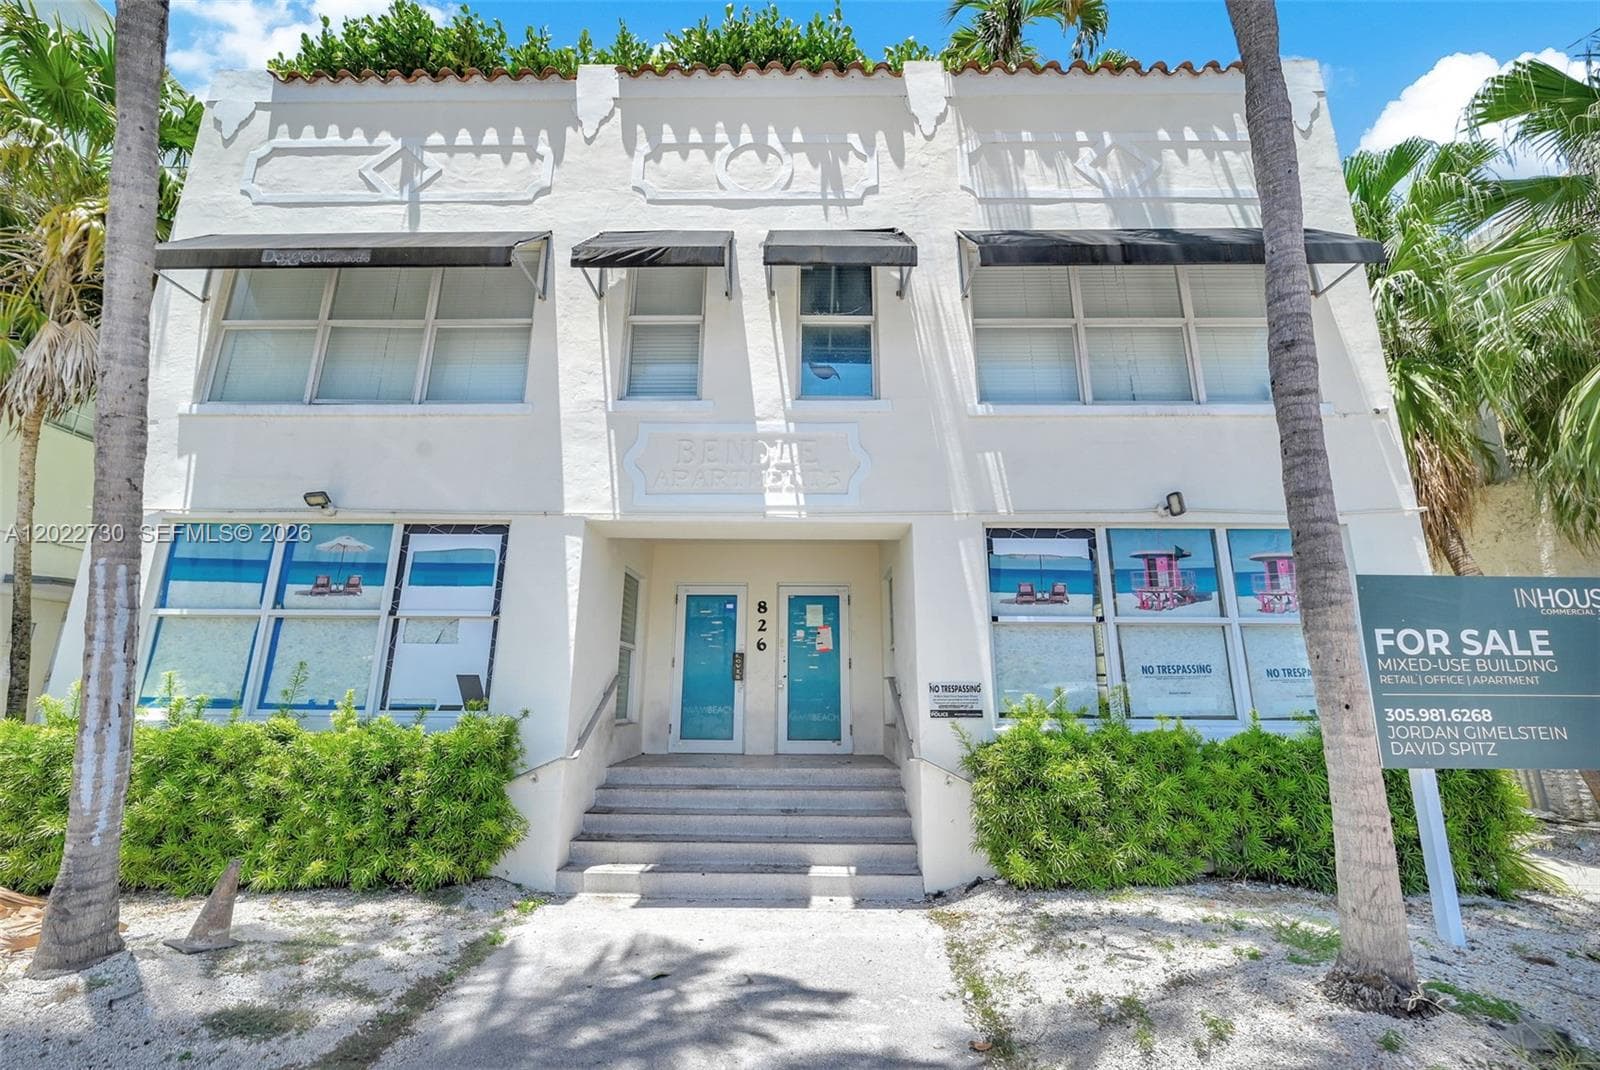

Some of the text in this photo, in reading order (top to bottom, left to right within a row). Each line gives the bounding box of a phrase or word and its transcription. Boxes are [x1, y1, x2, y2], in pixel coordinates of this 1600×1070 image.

[1540, 608, 1596, 616] COMMERCIAL
[1374, 628, 1554, 656] FOR SALE
[1141, 664, 1212, 675] NO TRESPASSING
[1377, 658, 1558, 673] MIXED-USE BUILDING
[1266, 668, 1280, 678] NO
[1380, 675, 1541, 685] RETAIL OFFICE APARTMENT
[929, 684, 982, 693] NO TRESPASSING
[1384, 708, 1493, 722] 305.981.6268
[1387, 726, 1568, 741] JORDAN GIMELSTEIN
[1390, 742, 1498, 756] DAVID SPITZ
